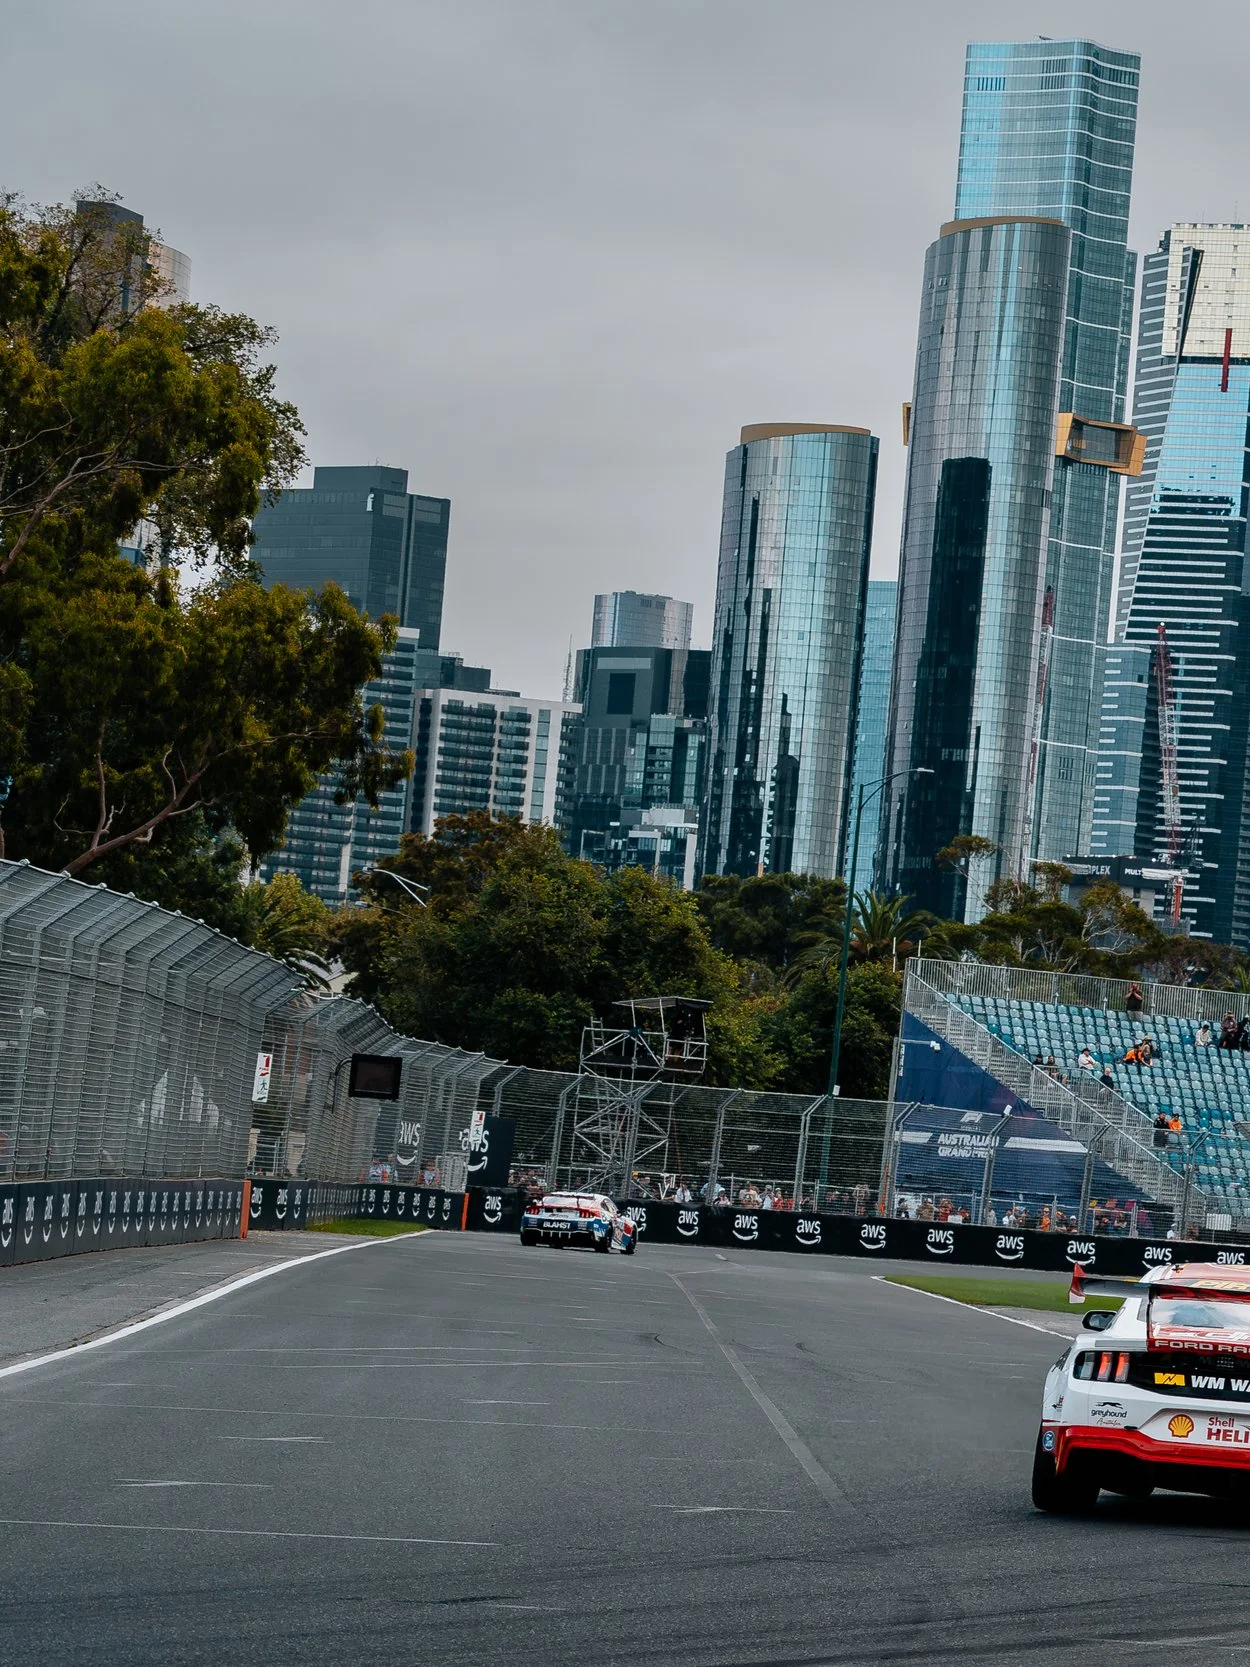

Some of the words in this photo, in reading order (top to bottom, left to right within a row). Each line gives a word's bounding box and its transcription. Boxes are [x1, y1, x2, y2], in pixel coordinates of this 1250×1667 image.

[485, 1196, 502, 1211] aws
[678, 1210, 699, 1225] aws
[734, 1214, 758, 1230] aws
[796, 1219, 821, 1234] aws
[861, 1223, 886, 1239] aws
[927, 1228, 954, 1244] aws
[996, 1235, 1024, 1250] aws
[1067, 1240, 1095, 1255] aws
[1144, 1246, 1172, 1262] aws
[1217, 1251, 1245, 1265] aws
[1154, 1339, 1213, 1350] FORD
[1191, 1375, 1225, 1390] WM
[1091, 1409, 1128, 1418] greyhound
[1208, 1417, 1235, 1428] Shell
